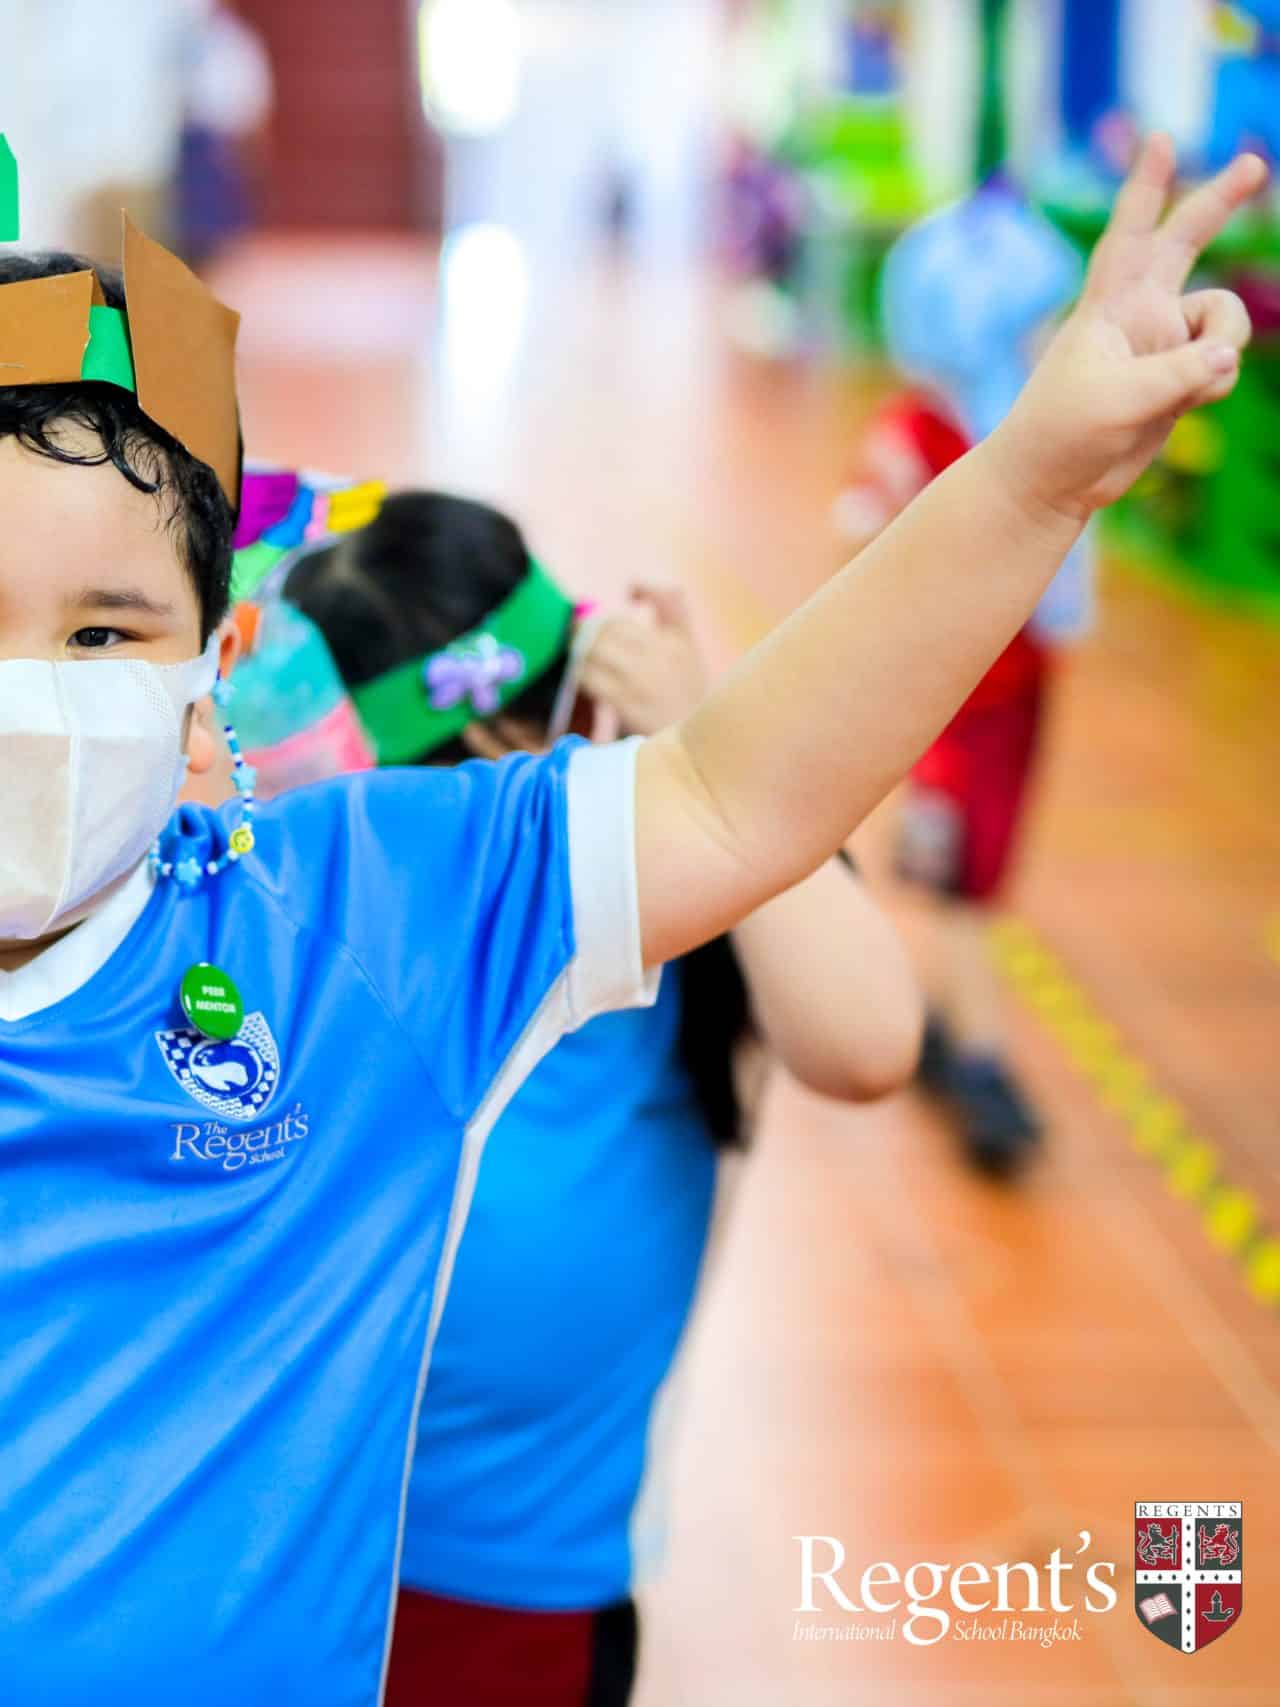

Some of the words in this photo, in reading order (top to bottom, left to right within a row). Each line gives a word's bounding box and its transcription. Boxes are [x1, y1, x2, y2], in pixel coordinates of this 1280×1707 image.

[201, 985, 225, 997] PEER
[195, 1000, 236, 1013] MENTOR
[203, 1120, 228, 1136] The
[170, 1103, 309, 1171] Regent's
[248, 1149, 286, 1165] School
